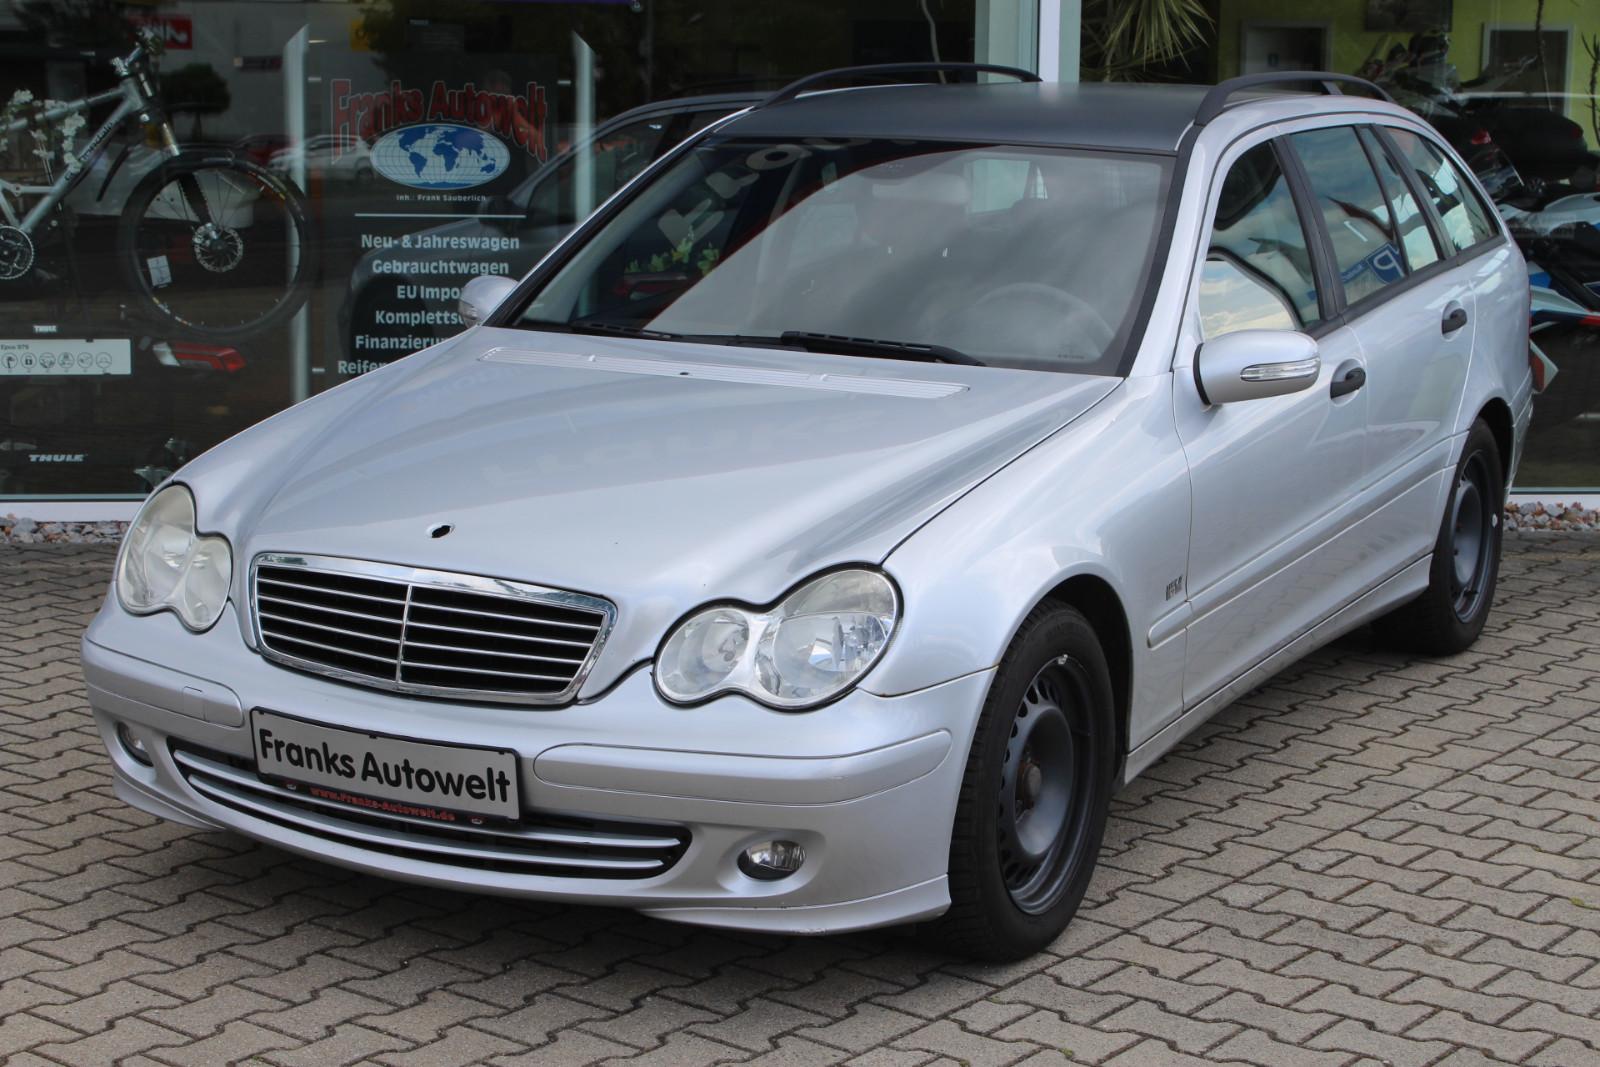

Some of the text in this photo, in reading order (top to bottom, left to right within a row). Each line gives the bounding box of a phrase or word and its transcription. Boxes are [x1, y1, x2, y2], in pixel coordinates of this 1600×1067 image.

[331, 78, 548, 165] Franks Autowelt
[361, 234, 520, 251] Neu- & Jahreswagen
[372, 259, 509, 275] Gebrauchtwagen
[397, 285, 463, 302] EU Impo
[28, 454, 85, 462] THULE
[259, 728, 511, 802] Franks Autowelt
